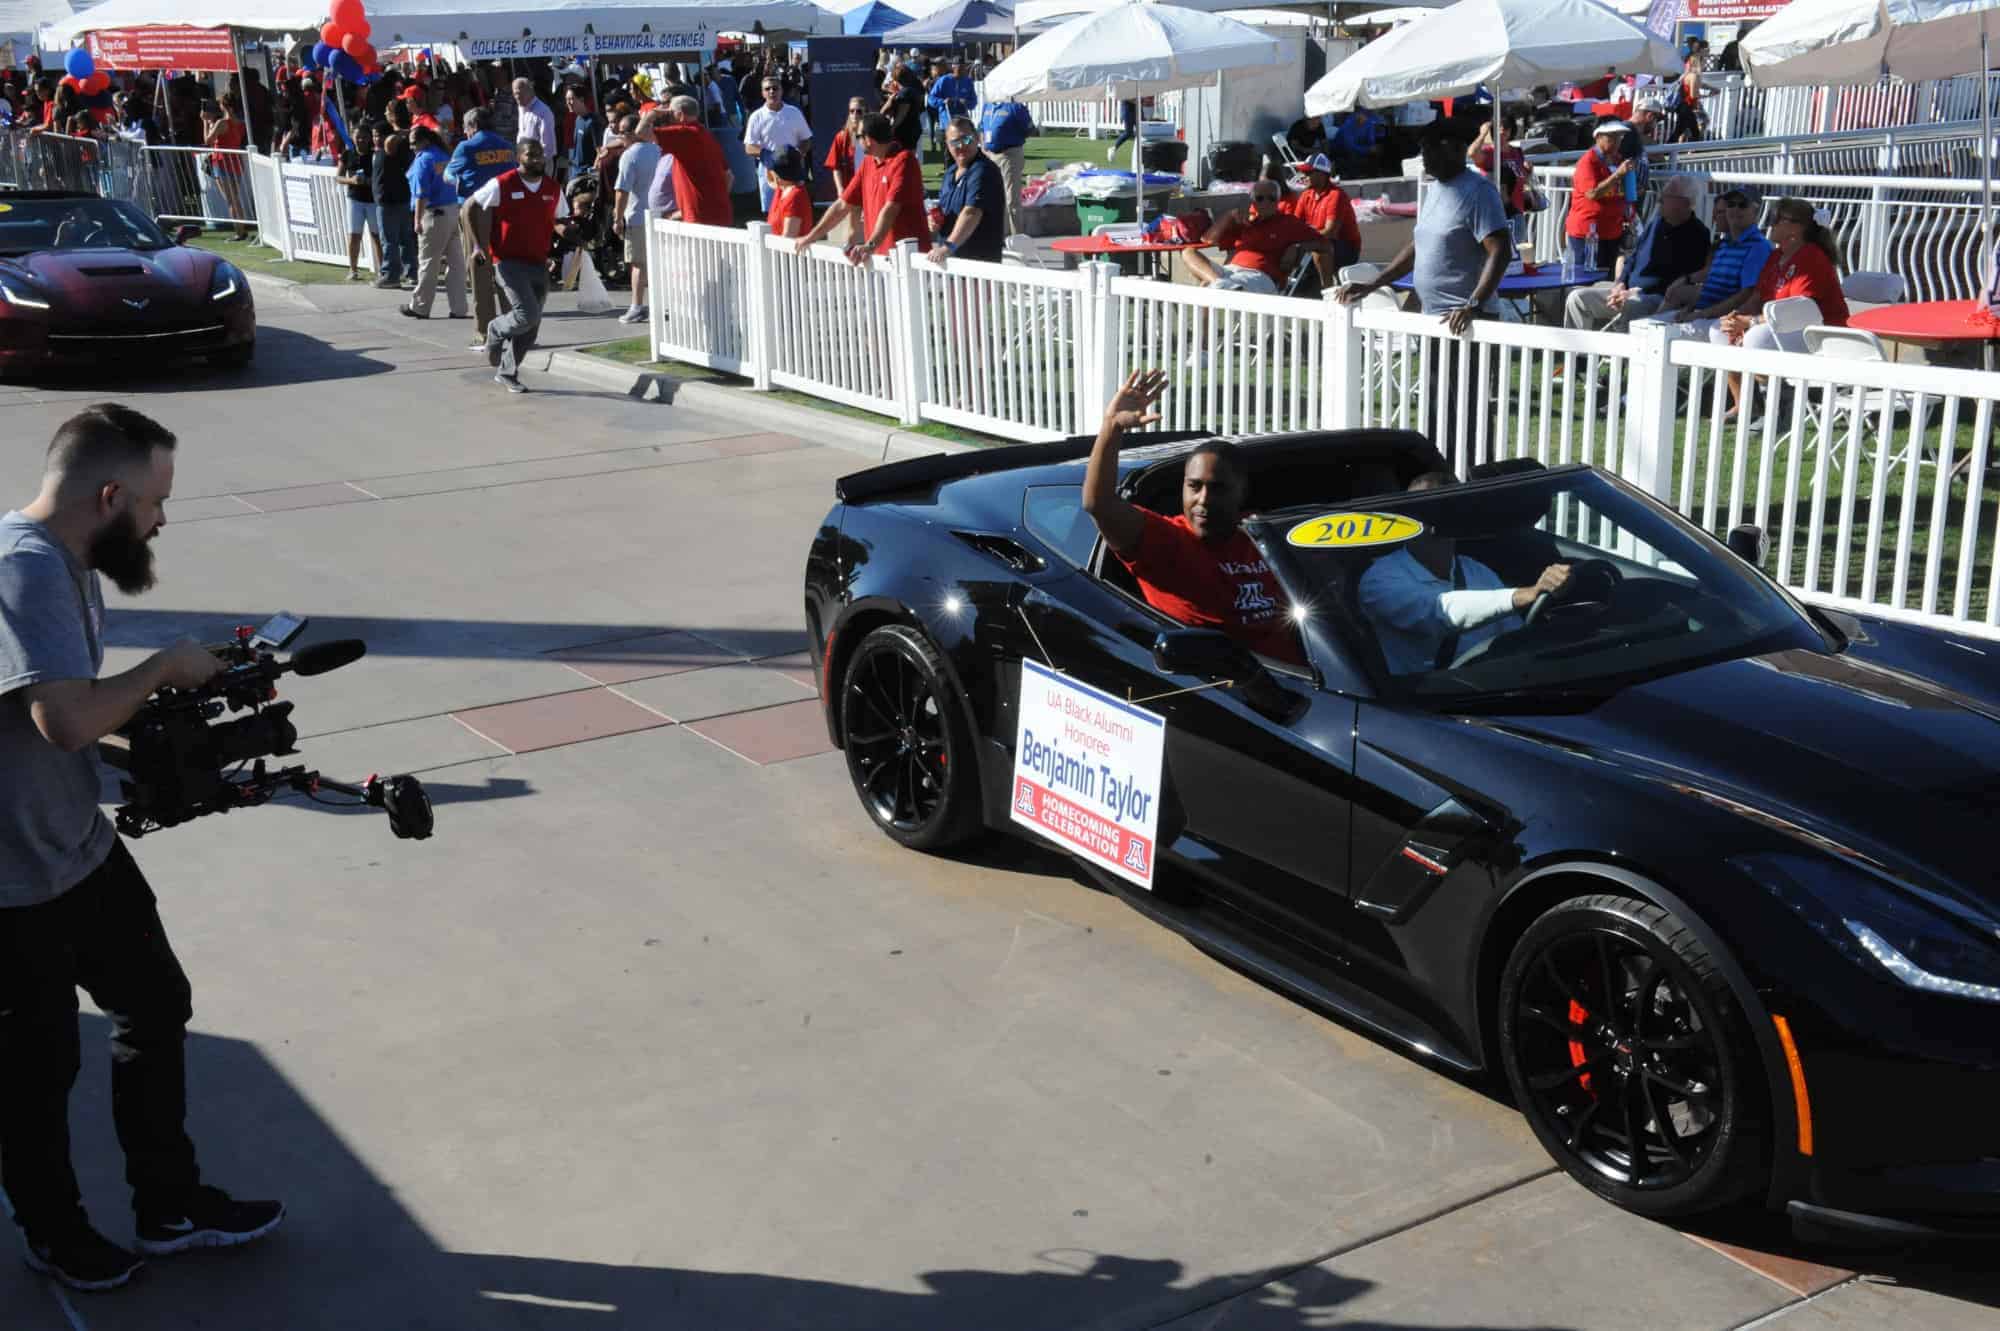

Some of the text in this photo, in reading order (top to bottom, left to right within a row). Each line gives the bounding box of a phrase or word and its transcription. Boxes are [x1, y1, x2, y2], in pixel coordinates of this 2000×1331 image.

[1697, 7, 1719, 17] BEAR
[1720, 7, 1746, 16] DOWN
[471, 40, 518, 56] COLLEGE
[523, 38, 537, 55] OF
[542, 36, 579, 52] SOCIAL
[594, 33, 656, 50] BEHAVIORAL
[659, 31, 705, 48] SCIENCES
[1314, 518, 1398, 543] 2017
[1047, 689, 1133, 744] UA Black Alumni
[1064, 723, 1111, 757] Honoree
[1022, 728, 1152, 825] Benjamin Taylor
[1041, 809, 1119, 859] CELEBRATION
[1042, 793, 1121, 843] HOMECOMING
